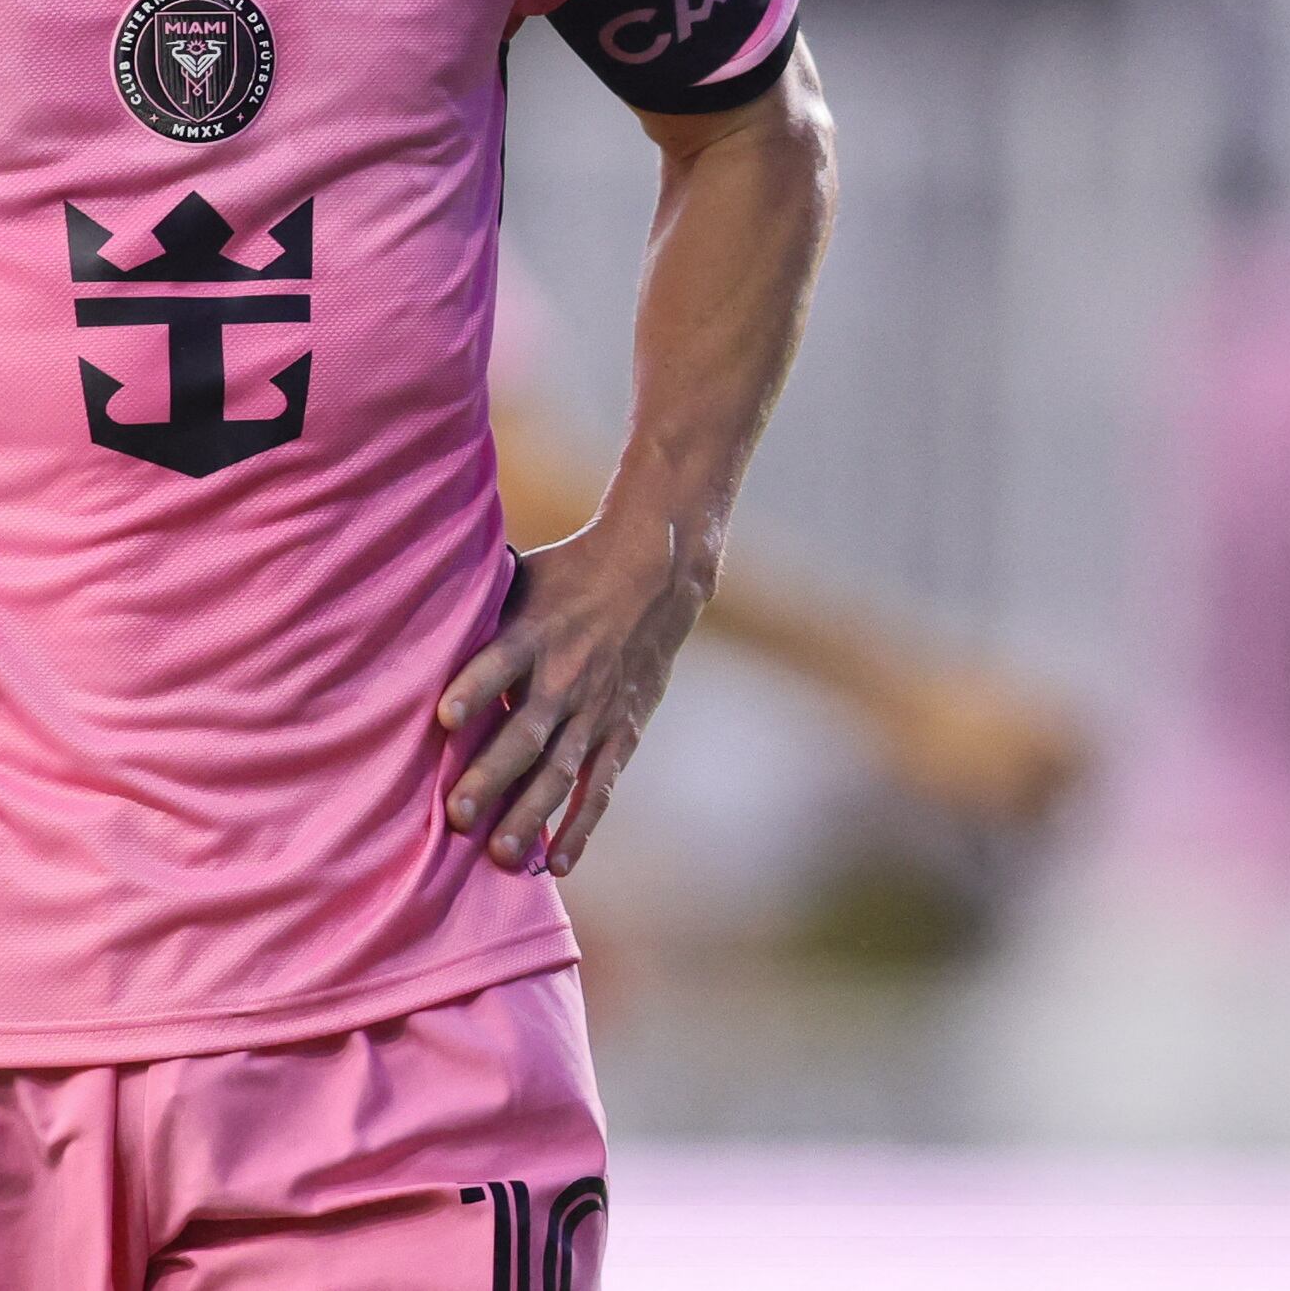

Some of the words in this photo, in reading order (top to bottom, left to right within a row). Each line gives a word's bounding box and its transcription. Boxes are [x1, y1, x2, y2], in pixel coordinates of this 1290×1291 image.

[165, 21, 227, 34] MIAMI
[119, 61, 142, 105] CLUB
[247, 12, 265, 34] DE
[172, 122, 224, 138] MMXX
